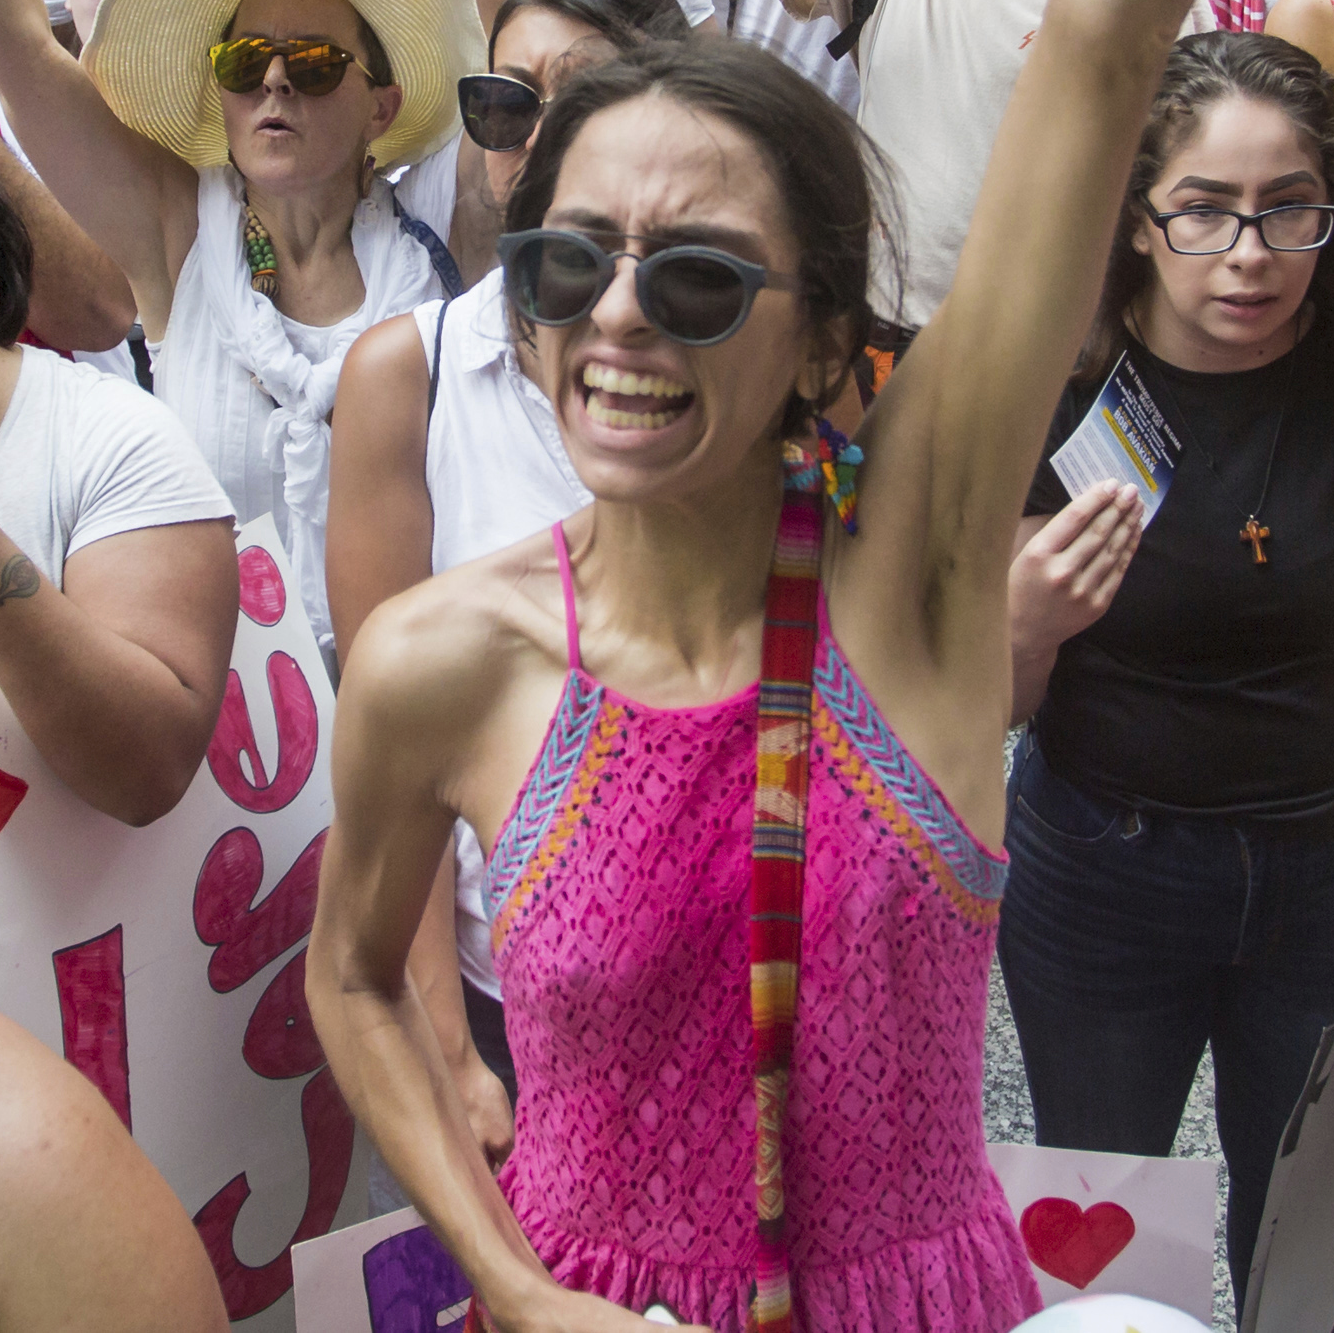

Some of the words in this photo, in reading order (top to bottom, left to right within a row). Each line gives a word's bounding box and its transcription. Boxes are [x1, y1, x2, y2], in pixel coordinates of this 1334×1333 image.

[1112, 410, 1129, 431] BOB
[1126, 431, 1156, 473] AVAKIAN
[1123, 360, 1135, 375] THE
[1162, 423, 1182, 450] REGIME
